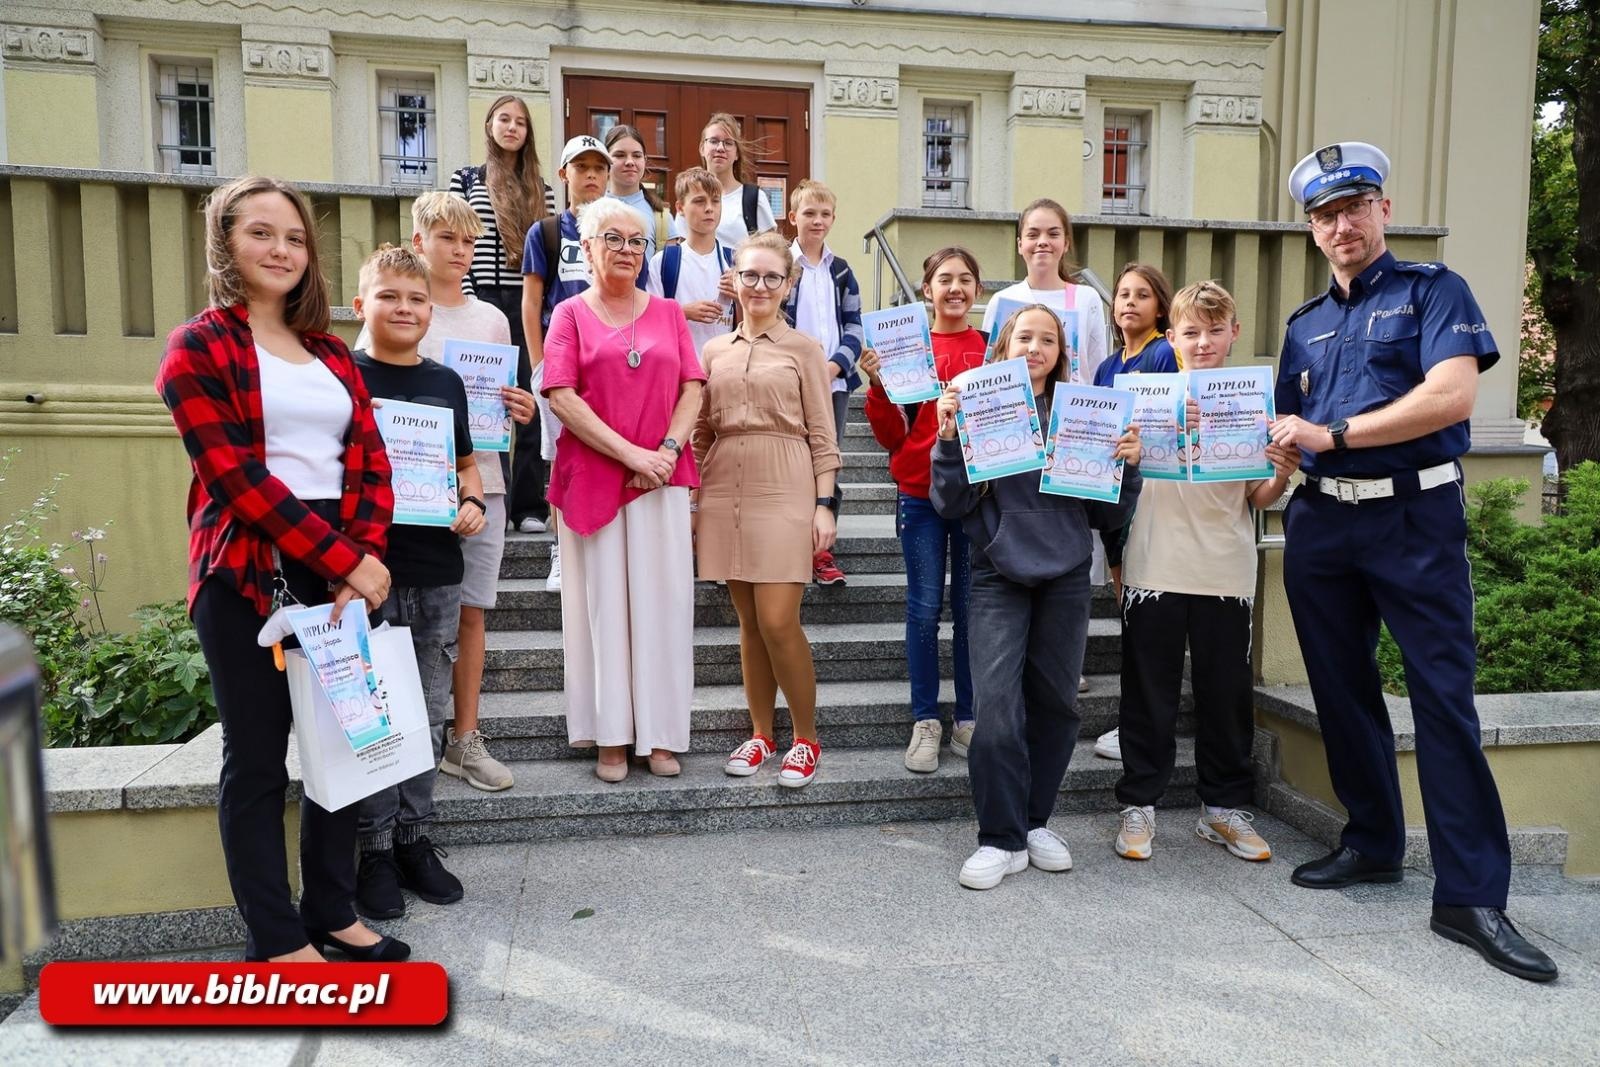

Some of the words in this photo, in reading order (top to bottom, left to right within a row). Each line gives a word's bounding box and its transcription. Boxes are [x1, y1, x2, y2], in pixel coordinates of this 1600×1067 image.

[878, 316, 914, 330] DYPLOM
[460, 354, 503, 366] DYPLOM
[967, 374, 1012, 391] DYPLOM
[1208, 380, 1256, 391] DYPLOM
[1070, 398, 1118, 410] DYPLOM
[392, 415, 438, 429] DYPLOM
[335, 654, 359, 664] miejsca
